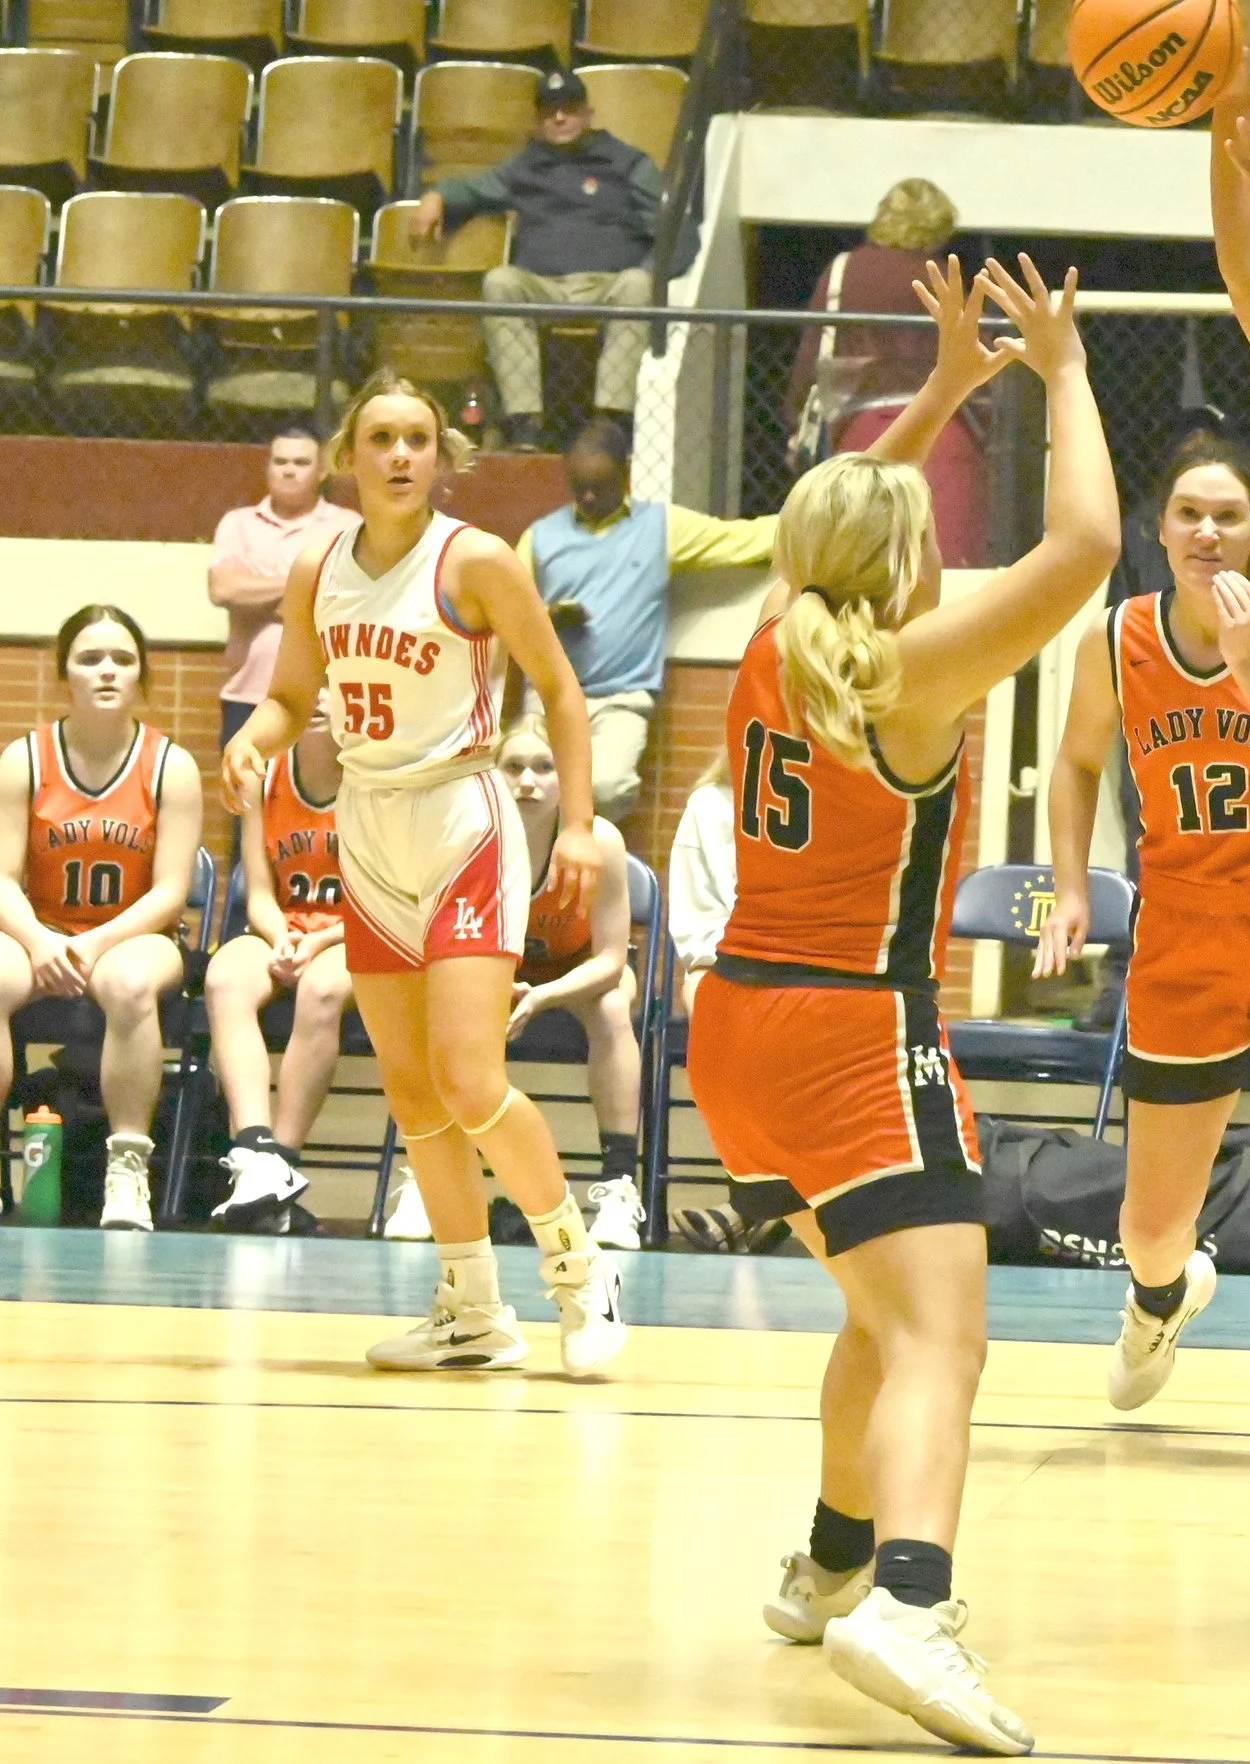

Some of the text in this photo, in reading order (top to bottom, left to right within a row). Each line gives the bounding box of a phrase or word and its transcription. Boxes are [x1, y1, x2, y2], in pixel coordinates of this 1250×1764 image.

[1092, 32, 1188, 105] Wilson
[1145, 70, 1215, 124] NCAA
[338, 682, 396, 741] 55
[1134, 707, 1205, 756] LADY
[741, 717, 813, 853] 15
[1170, 762, 1250, 834] 12
[47, 819, 91, 850] ADY
[274, 831, 317, 863] ADY
[62, 860, 123, 908] 10
[453, 897, 484, 940] LA
